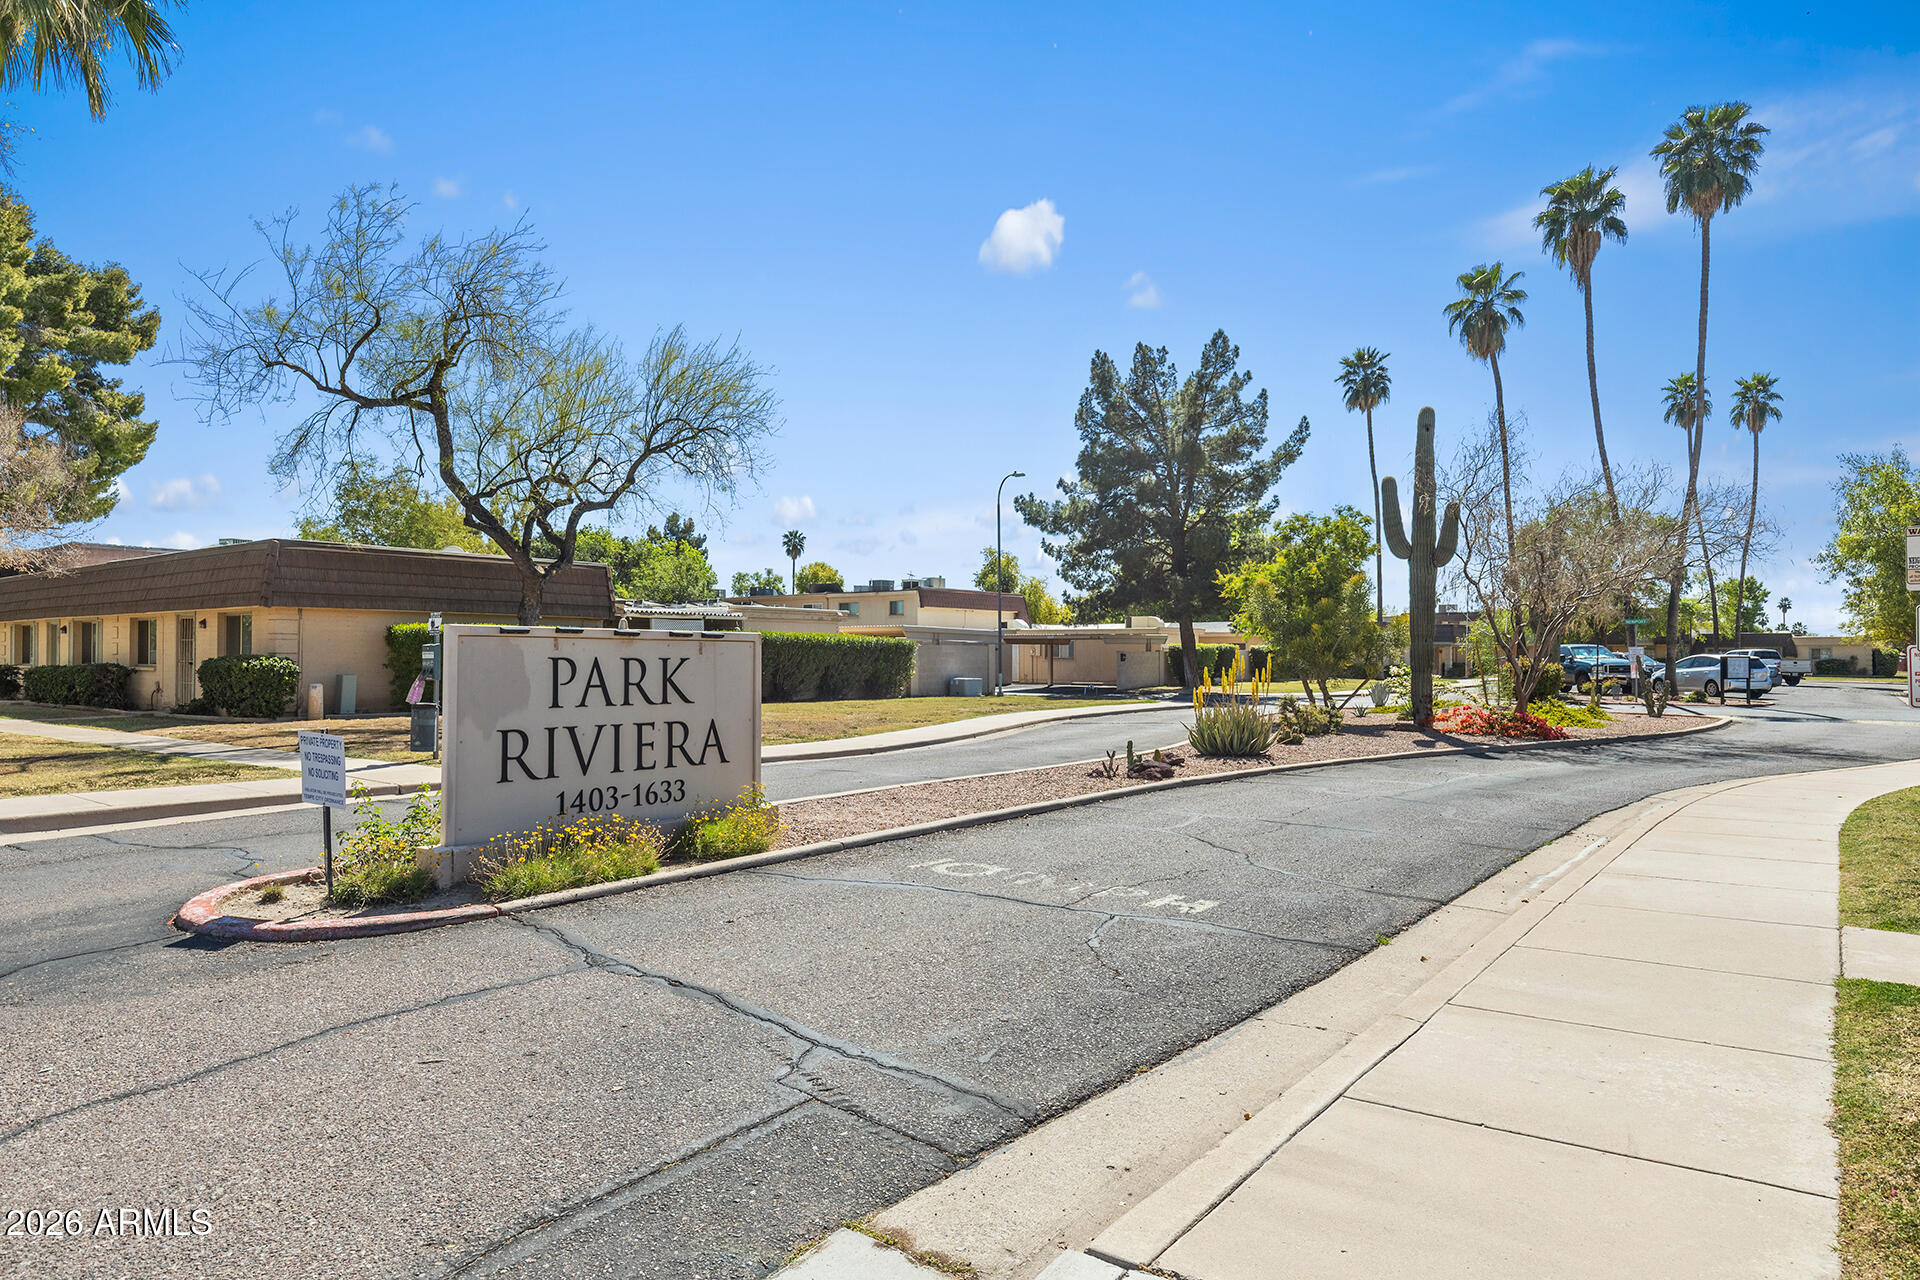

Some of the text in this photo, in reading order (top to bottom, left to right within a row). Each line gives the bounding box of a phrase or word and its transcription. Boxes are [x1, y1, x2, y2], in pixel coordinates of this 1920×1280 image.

[548, 656, 695, 709] PARK
[300, 735, 342, 750] PRIVATE PROPERTY
[496, 718, 730, 784] RIVIERA
[304, 751, 341, 766] NO TRESPASSING
[308, 767, 339, 781] NO SOLICITING
[556, 779, 686, 816] 1403-1633
